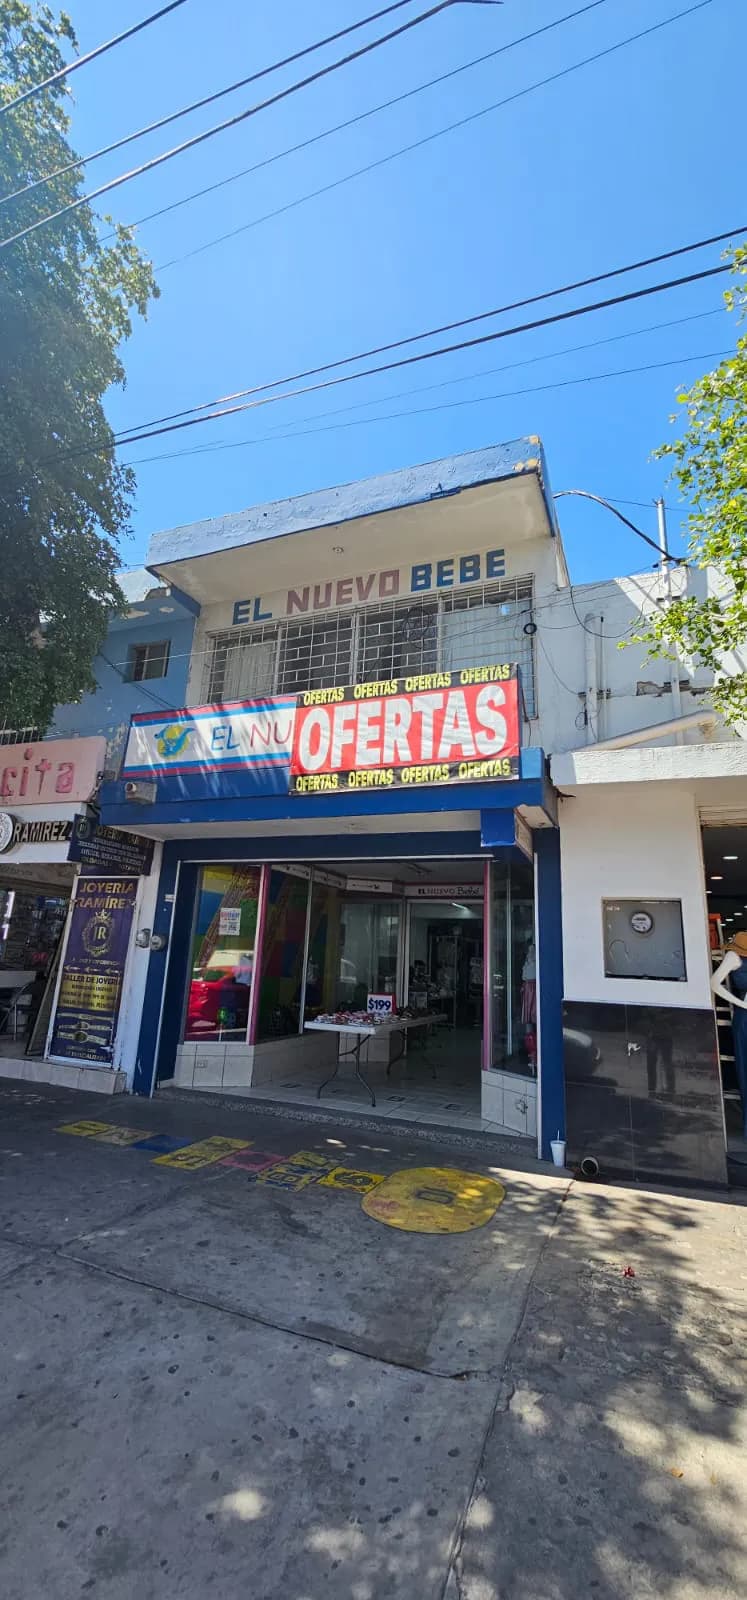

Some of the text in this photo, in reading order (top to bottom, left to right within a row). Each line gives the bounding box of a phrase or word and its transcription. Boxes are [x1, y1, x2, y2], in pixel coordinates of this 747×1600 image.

[232, 549, 505, 625] EL NUEVO BEBE
[303, 665, 510, 706] OFERTAS OFERTAS OFERTAS OFERTAS
[211, 725, 240, 750] EL
[299, 685, 508, 771] OFERTAS
[296, 759, 510, 792] OFERTAS OFERTAS OFERTAS OFERTAS
[12, 821, 68, 842] RAMIREZ
[80, 883, 134, 894] JOYERIA
[368, 997, 391, 1011] $199
